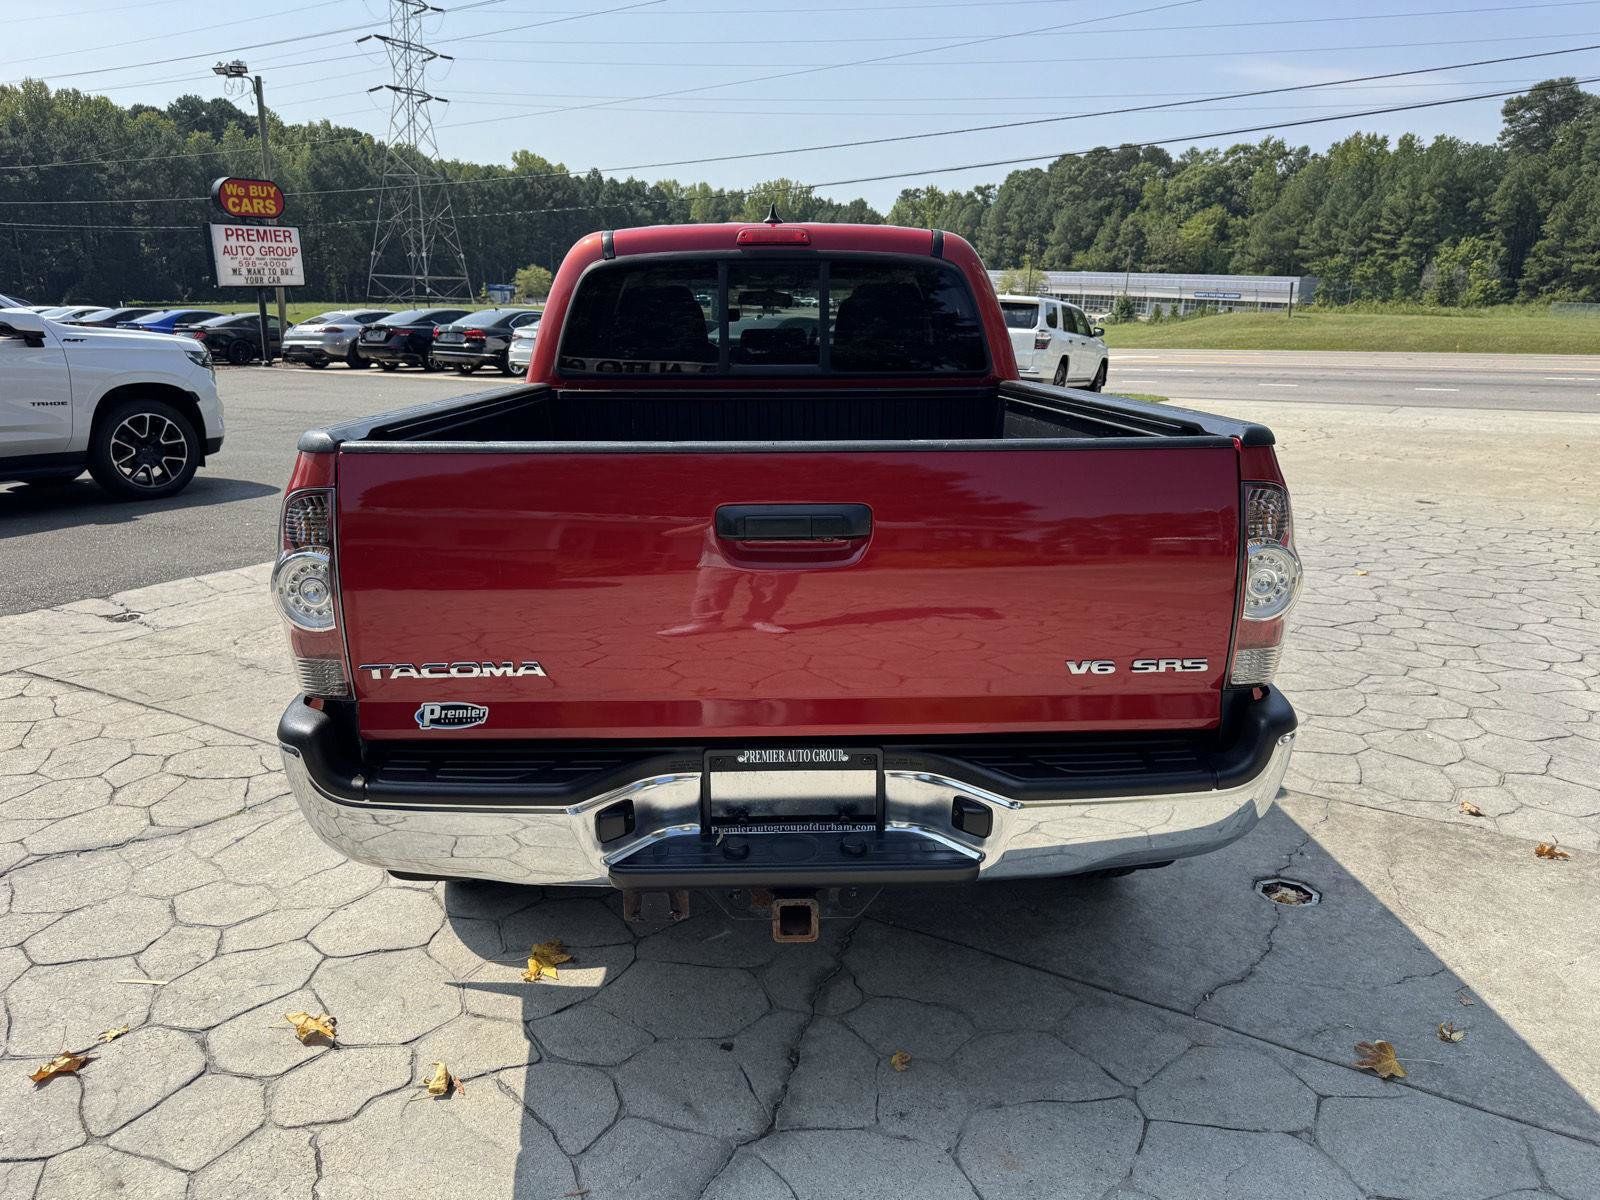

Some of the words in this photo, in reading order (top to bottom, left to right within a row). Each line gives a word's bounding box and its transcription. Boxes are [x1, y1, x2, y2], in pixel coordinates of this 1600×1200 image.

[224, 183, 245, 196] We
[249, 185, 277, 198] BUY
[227, 197, 277, 215] CARS
[224, 227, 293, 243] PREMIER
[222, 245, 255, 257] AUTO
[259, 246, 299, 257] GROUP
[232, 268, 242, 276] WE
[247, 268, 265, 276] WANT
[268, 268, 277, 276] TO
[280, 268, 294, 276] BUY
[244, 276, 264, 284] YOUR
[267, 276, 281, 284] CAR
[358, 661, 547, 680] TACOMA
[1066, 660, 1116, 675] V6
[1131, 658, 1209, 673] SR5
[422, 703, 486, 727] Premier
[744, 749, 785, 763] PREMIER
[786, 749, 811, 763] AUTO
[812, 749, 844, 763] GROUP
[711, 823, 877, 834] Premierautogroupofdurham.com
